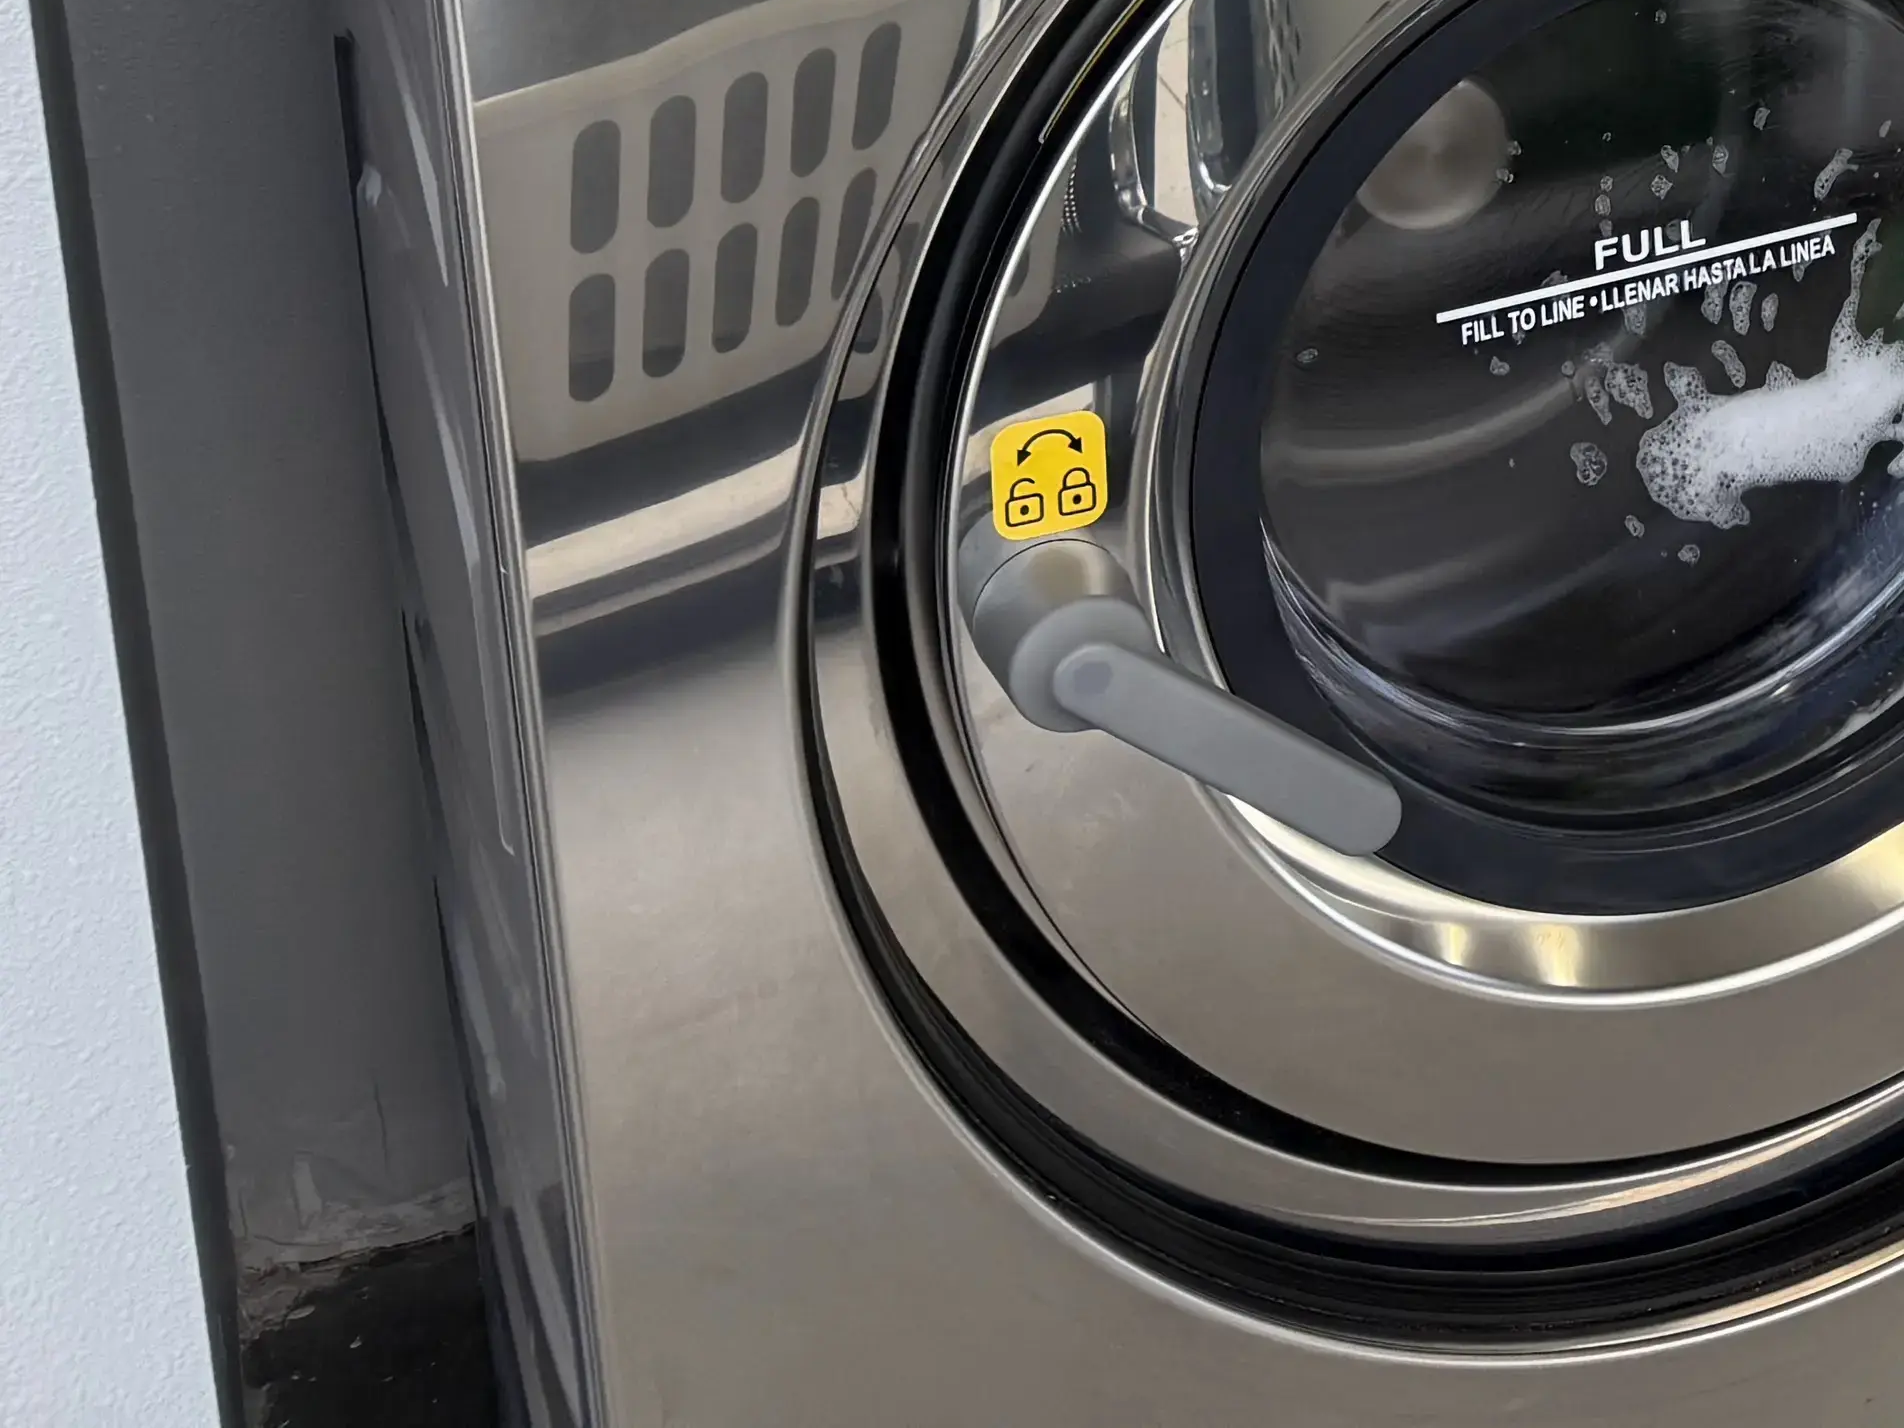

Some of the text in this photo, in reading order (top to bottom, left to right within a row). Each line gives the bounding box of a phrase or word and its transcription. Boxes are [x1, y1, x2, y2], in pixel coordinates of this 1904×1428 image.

[1594, 220, 1706, 271] FULL
[1461, 234, 1835, 345] FILL TO LINE LLENAR HASTA LA LINEA
